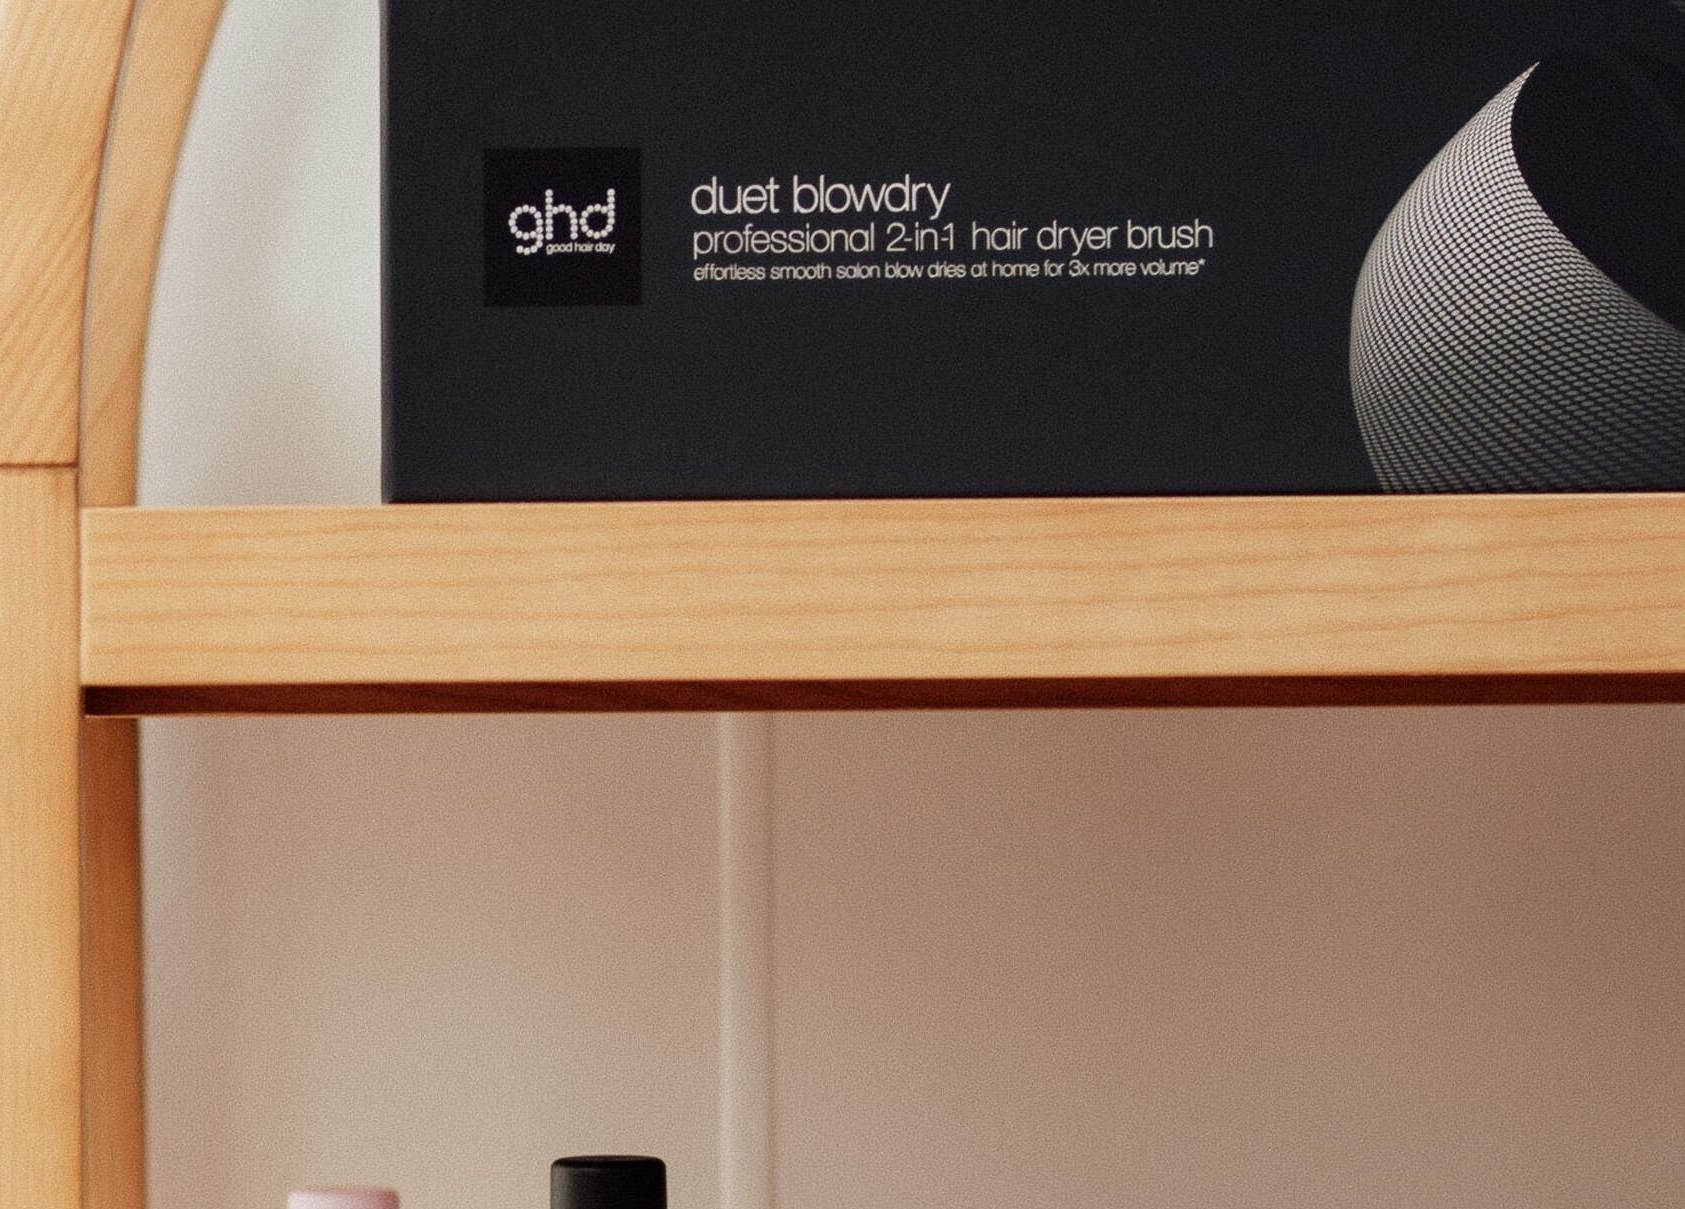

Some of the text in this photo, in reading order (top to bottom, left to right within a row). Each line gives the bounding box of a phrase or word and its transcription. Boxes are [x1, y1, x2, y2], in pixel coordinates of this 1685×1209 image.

[691, 174, 951, 220] duet blowdry
[508, 188, 615, 255] ghd
[693, 218, 1213, 260] professional 2-in-1 hair dryer brush
[546, 242, 615, 255] good hair day
[694, 263, 765, 281] effortless
[770, 263, 831, 280] smooth
[836, 263, 879, 279] salon
[884, 262, 924, 278] blow
[927, 261, 966, 277] dries
[971, 261, 987, 277] at
[992, 260, 1040, 277] home
[1043, 259, 1065, 276] for
[1069, 259, 1090, 276] 3x
[1093, 260, 1136, 276] more
